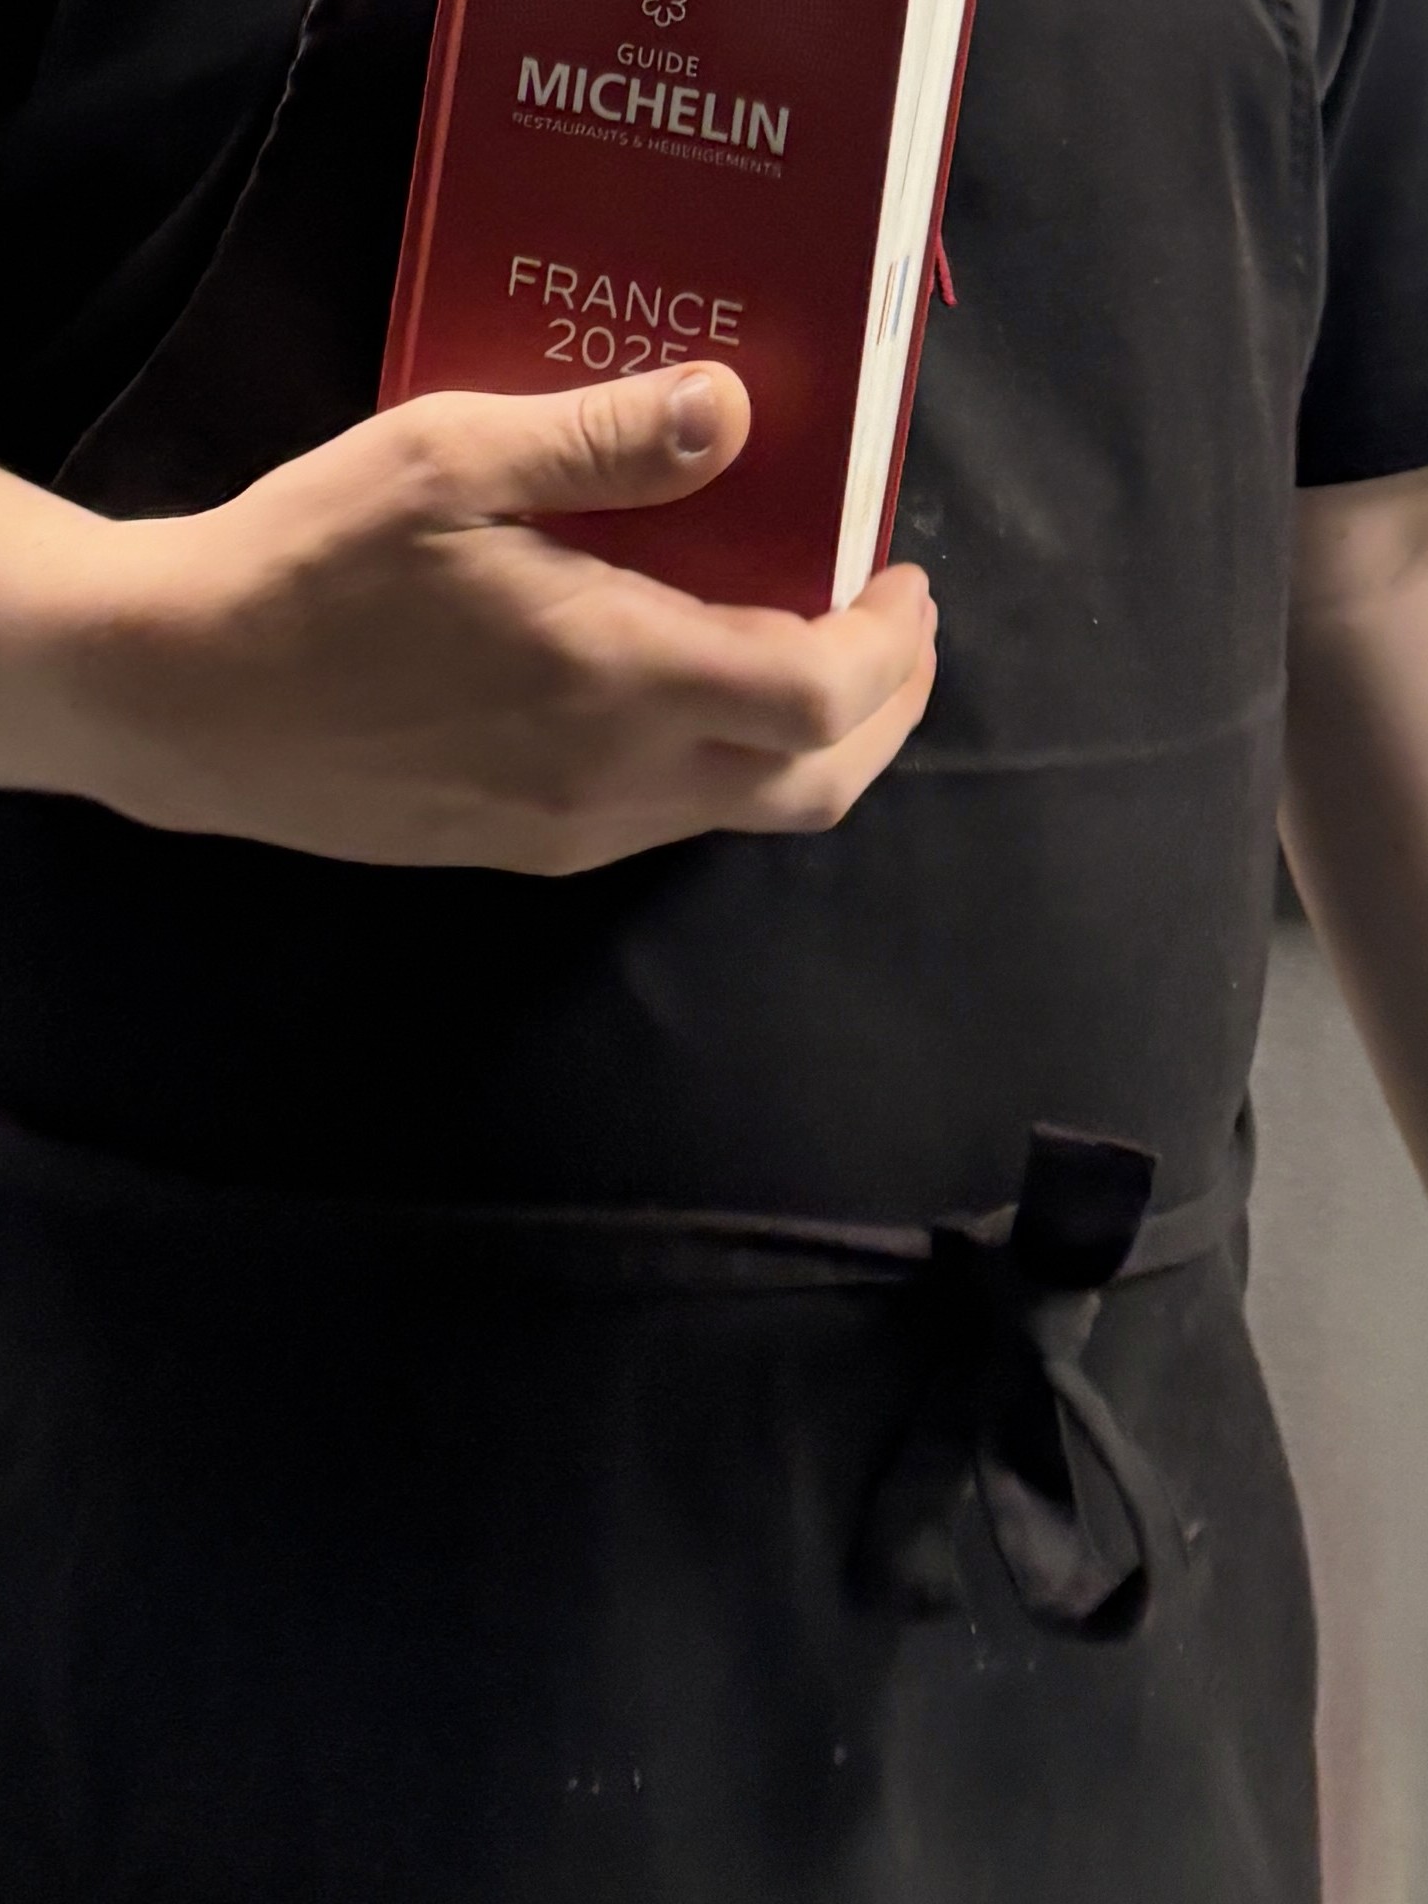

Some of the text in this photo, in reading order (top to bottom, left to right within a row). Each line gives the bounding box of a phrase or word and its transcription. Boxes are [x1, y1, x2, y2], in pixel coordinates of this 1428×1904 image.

[616, 41, 700, 78] GUIDE
[512, 110, 629, 147] RESTAURANTS
[632, 134, 643, 149] &
[516, 55, 790, 158] MICHELIN
[508, 254, 743, 348] FRANCE
